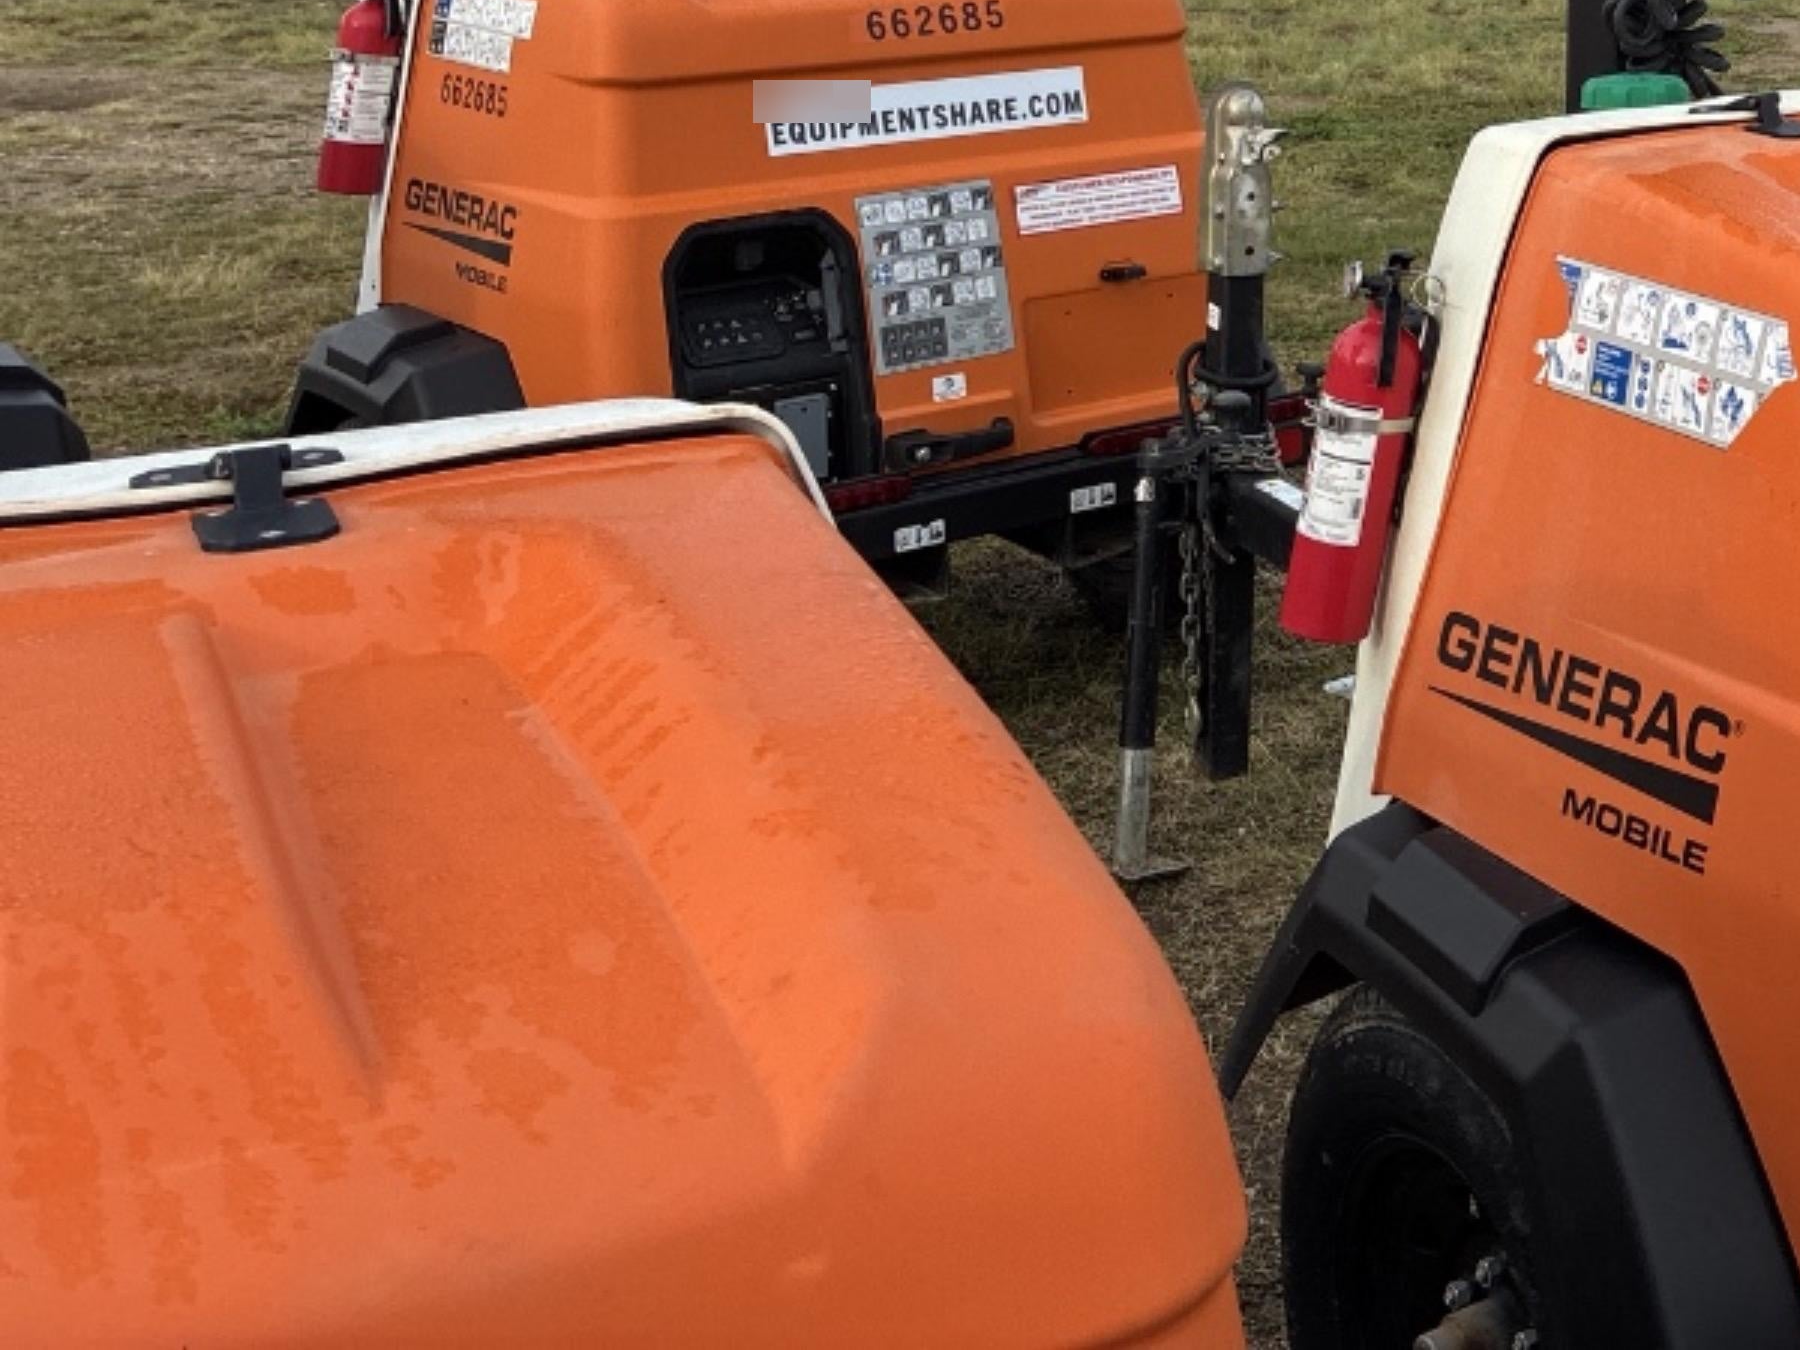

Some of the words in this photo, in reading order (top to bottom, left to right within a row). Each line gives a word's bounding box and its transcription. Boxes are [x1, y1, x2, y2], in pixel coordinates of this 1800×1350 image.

[866, 0, 1004, 40] 662685
[440, 73, 508, 118] 662685
[772, 89, 1083, 146] EQUIPMENTSHARE.COM
[405, 178, 518, 241] GENERAC
[455, 260, 508, 295] MOBILE
[1562, 787, 1709, 876] MOBILE
